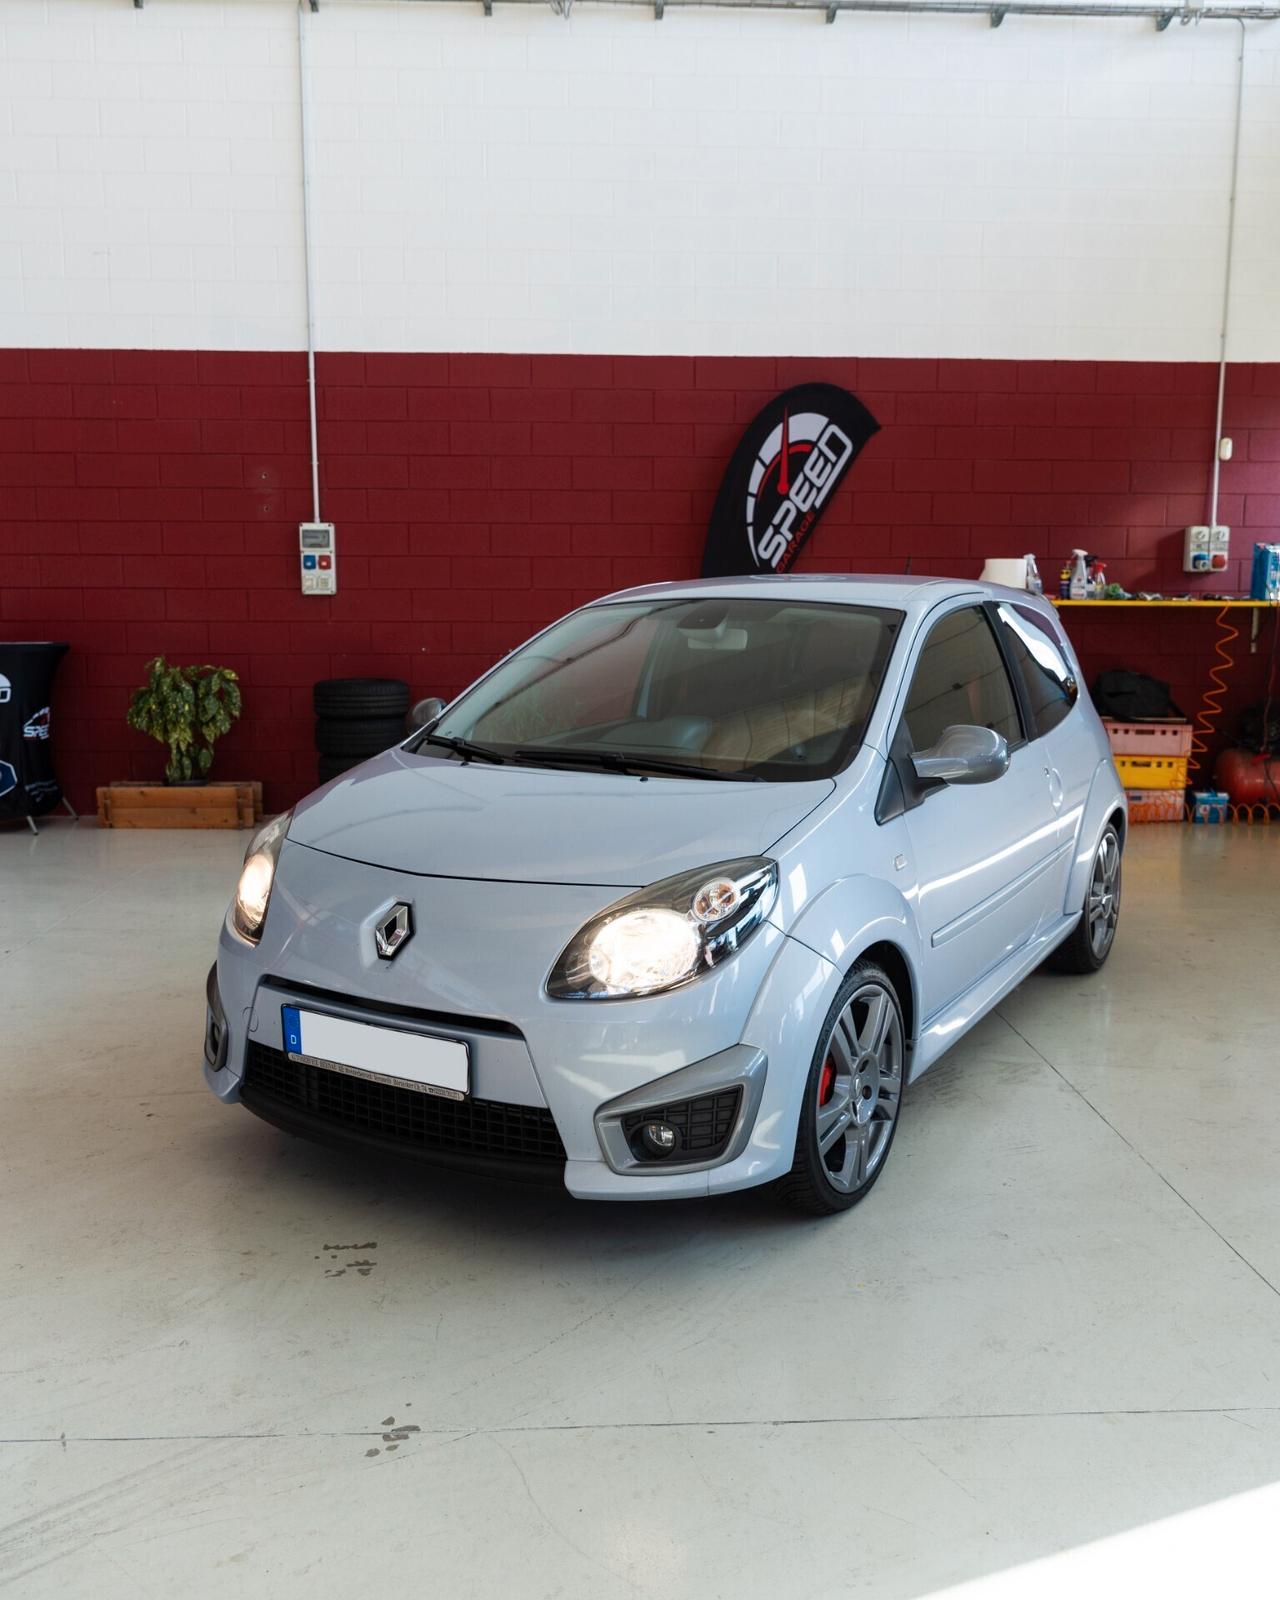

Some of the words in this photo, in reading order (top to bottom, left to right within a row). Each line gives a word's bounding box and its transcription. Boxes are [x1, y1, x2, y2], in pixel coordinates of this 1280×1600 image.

[757, 423, 853, 569] SPEED
[776, 510, 815, 574] GARAGE
[291, 1034, 297, 1045] D
